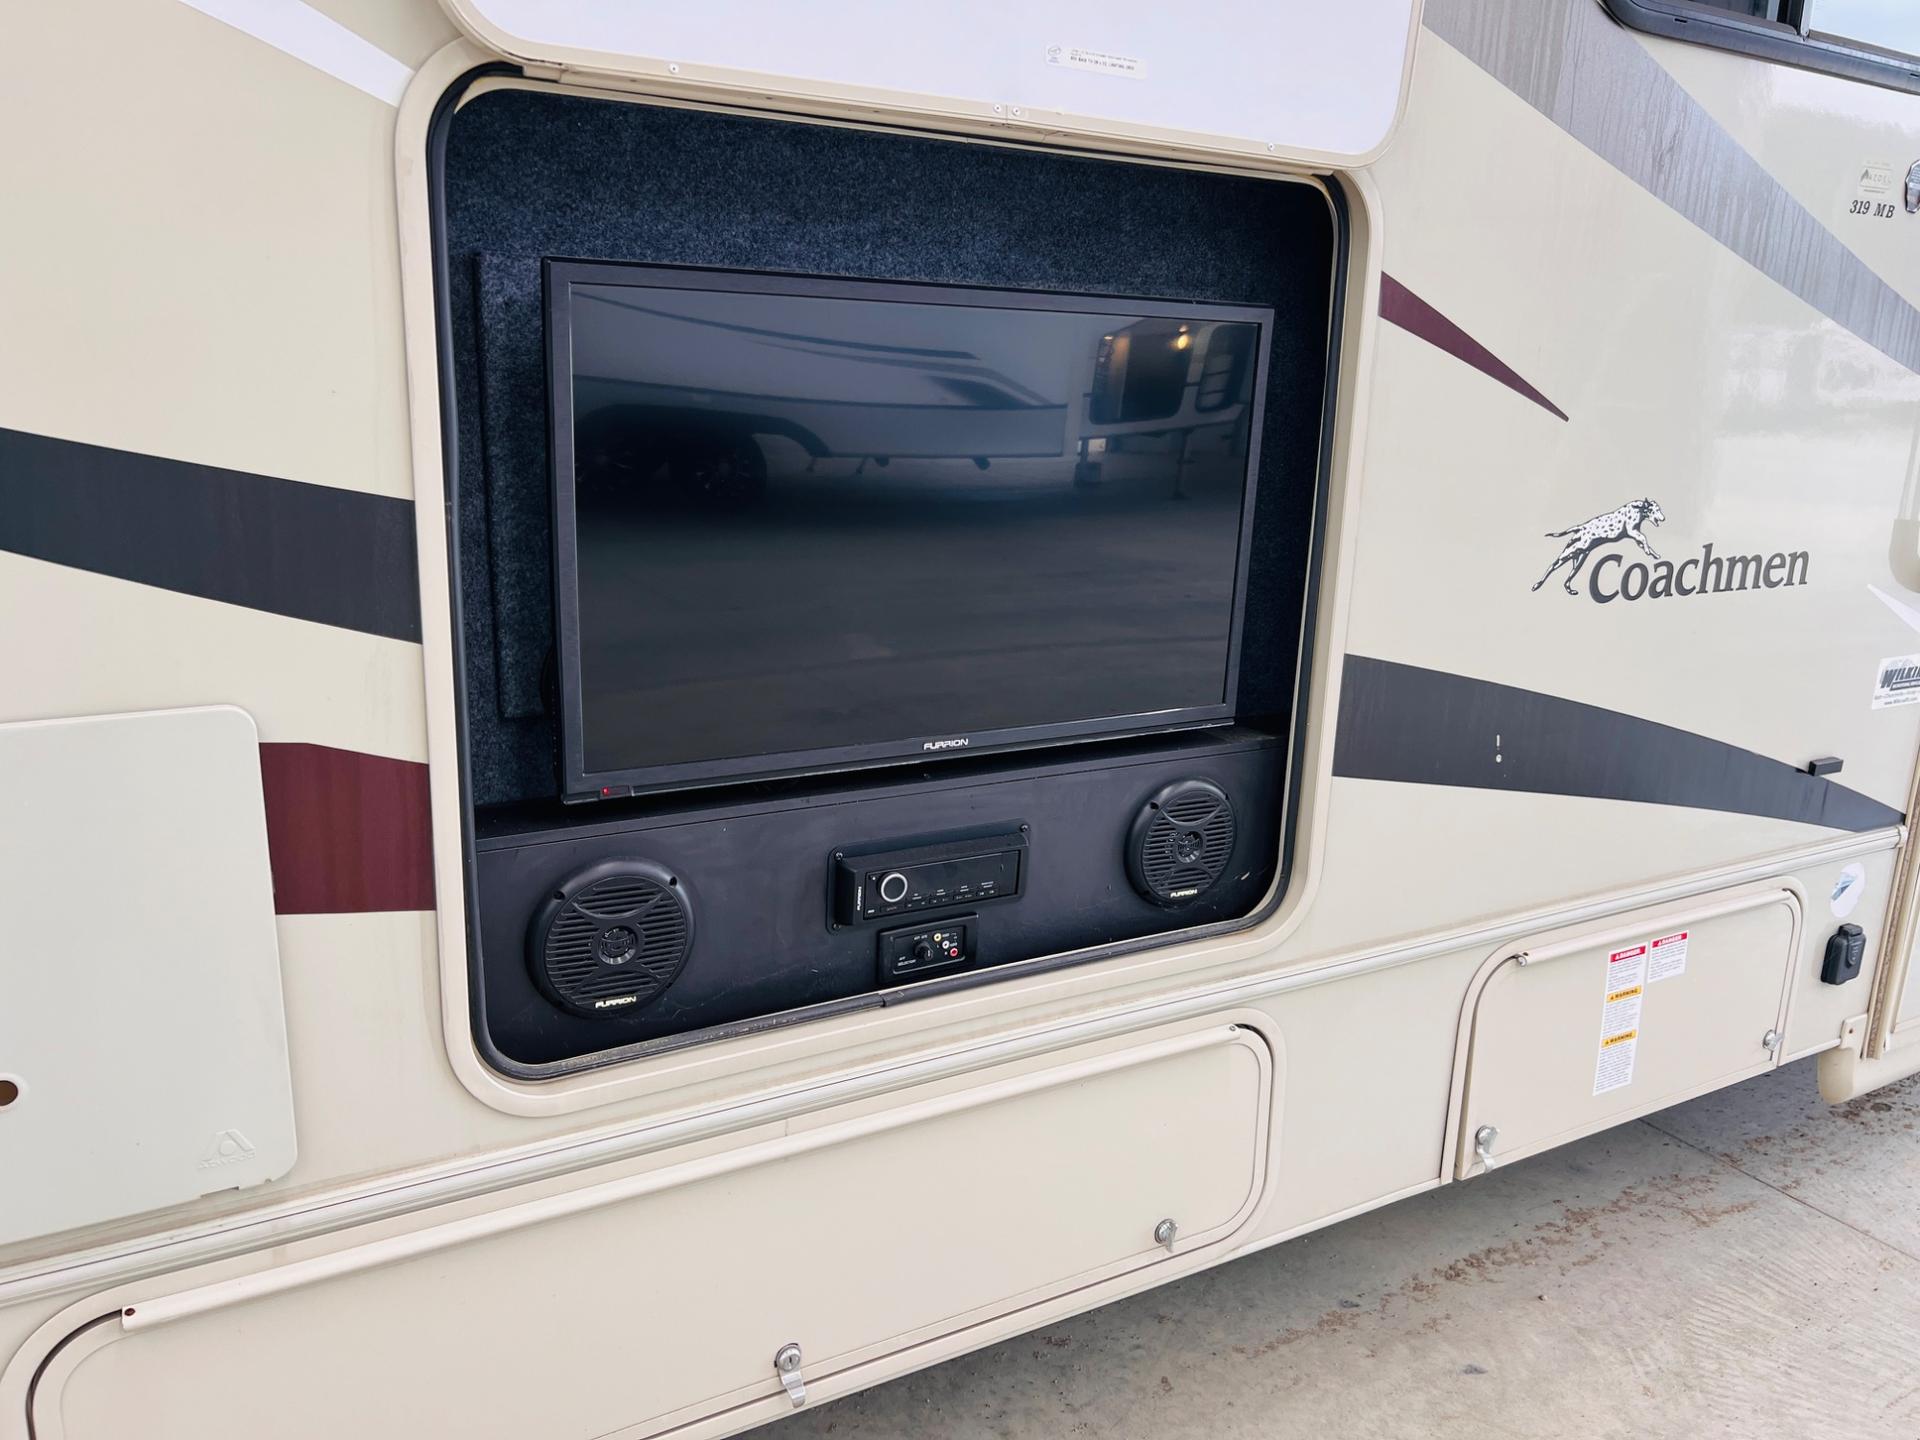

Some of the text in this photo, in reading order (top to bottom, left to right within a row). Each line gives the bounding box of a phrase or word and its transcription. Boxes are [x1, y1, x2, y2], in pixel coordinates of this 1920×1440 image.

[1849, 199, 1871, 215] 319
[1589, 543, 1810, 604] Coachmen
[923, 738, 969, 750] FURRION
[1615, 988, 1638, 998] WARNING
[595, 995, 637, 1008] FURRION
